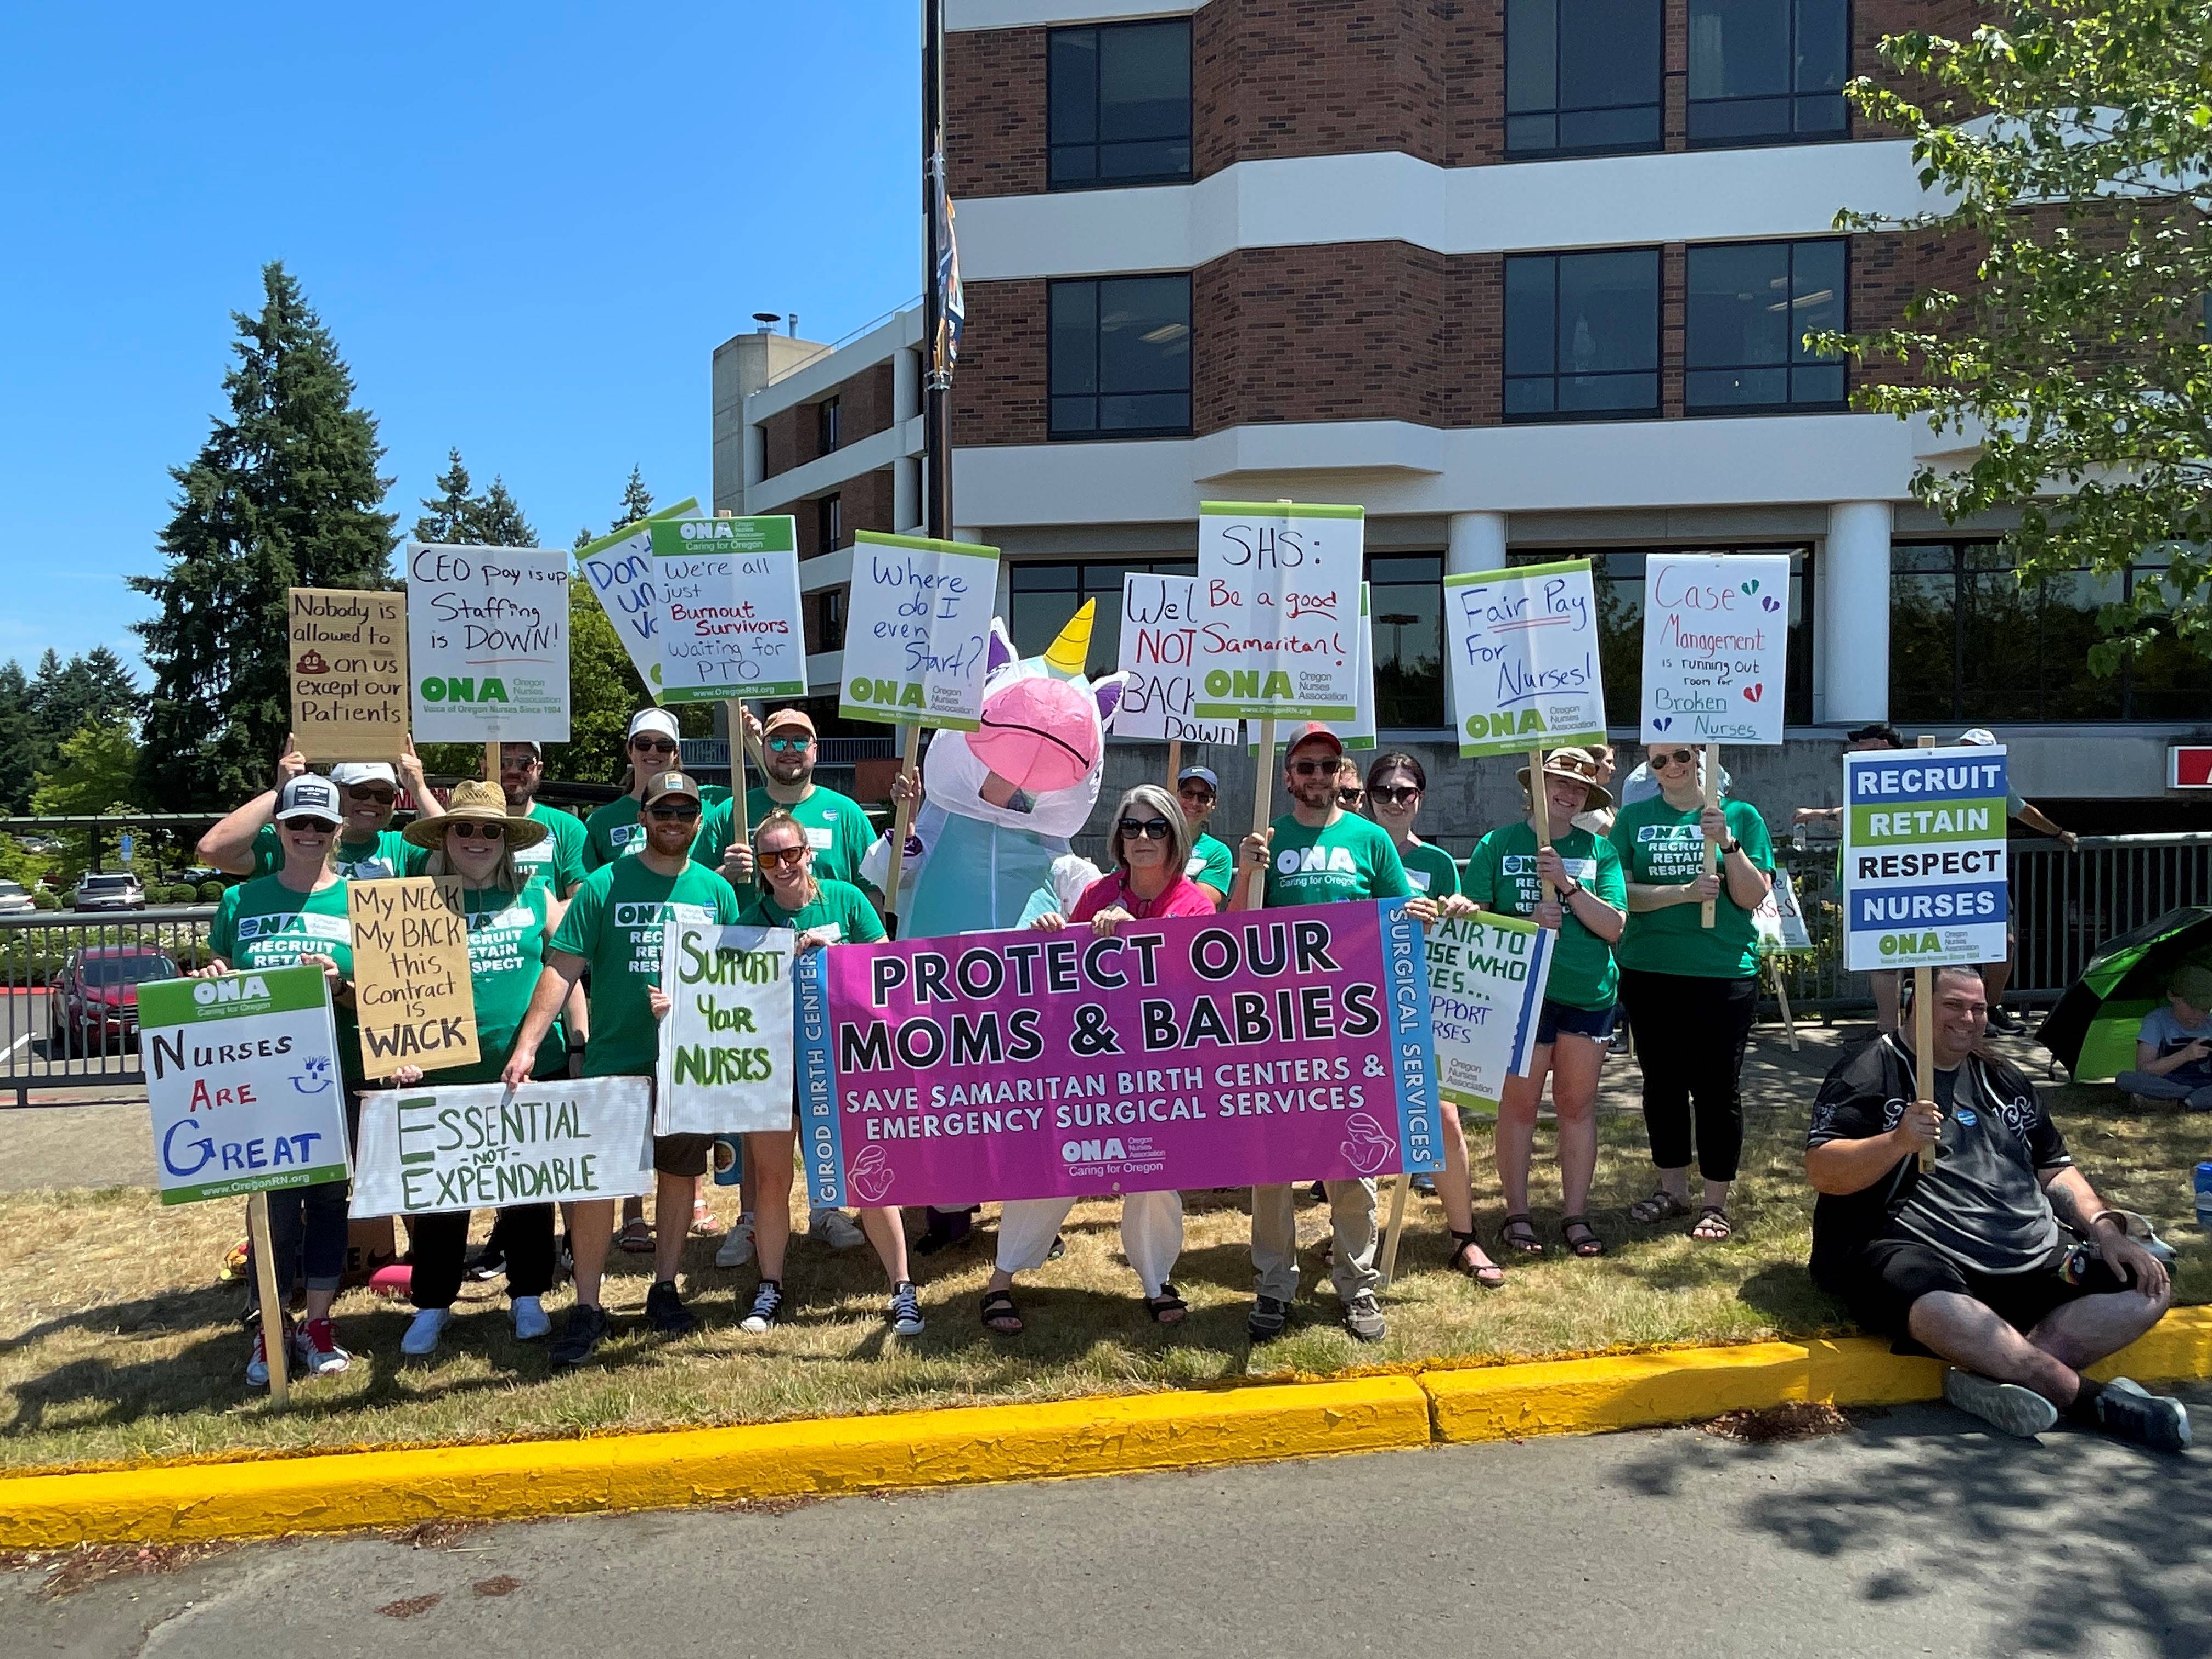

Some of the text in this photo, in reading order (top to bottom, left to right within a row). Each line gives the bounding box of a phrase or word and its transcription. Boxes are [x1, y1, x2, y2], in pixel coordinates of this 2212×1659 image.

[680, 522, 734, 540] ONA
[686, 540, 763, 551] Caring for Oregon
[1222, 525, 1321, 571] SHS:
[413, 550, 567, 586] CEO pay is up
[665, 557, 770, 579] We're all
[873, 556, 968, 592] Where
[658, 583, 701, 603] just
[1209, 579, 1337, 620] Be a good
[1656, 565, 1735, 610] Case
[294, 595, 397, 624] Nobody is
[431, 592, 540, 628] Staffing
[671, 601, 756, 622] Burnout
[898, 591, 960, 618] do I
[1460, 578, 1587, 631] Fair Pay
[293, 624, 391, 645] allowed to
[431, 625, 558, 653] is DOWN!
[694, 620, 789, 636] Survivors
[873, 620, 930, 639] even
[1660, 613, 1766, 658] Management
[752, 636, 786, 657] for
[1136, 628, 1197, 667] NOT
[1202, 622, 1346, 667] Samaritan!
[1466, 633, 1508, 665] For
[334, 656, 398, 674] on us
[697, 661, 760, 682] PTO
[905, 635, 983, 687] Start?
[1681, 658, 1729, 678] running
[296, 680, 403, 699] except our
[420, 676, 510, 702] ONA
[514, 678, 545, 688] Oregon
[1205, 669, 1295, 699] ONA
[1299, 672, 1332, 682] Oregon
[1299, 681, 1330, 691] Nurses
[1684, 676, 1711, 686] room
[693, 686, 775, 697] www.OregonRN.org
[850, 677, 926, 708] ONA
[932, 694, 959, 704] Nurses
[933, 686, 961, 697] Oregon
[1298, 691, 1347, 701] Association
[1656, 687, 1728, 711] Broken
[301, 701, 402, 723] Patients
[458, 705, 487, 715] Oregon
[489, 705, 517, 713] Nurses
[519, 706, 541, 714] Since
[930, 704, 974, 714] Association
[1549, 706, 1580, 715] Oregon
[1550, 714, 1579, 723] Nurses
[1466, 709, 1548, 740] ONA
[1551, 721, 1596, 731] Association
[1858, 765, 2001, 794] RECRUIT
[1870, 808, 1988, 837] RETAIN
[1277, 846, 1356, 874] ONA
[1859, 849, 2001, 878] RESPECT
[1279, 875, 1357, 888] Caring for Oregon
[355, 885, 460, 921] My NECK
[618, 905, 676, 924] ONA
[1863, 891, 1995, 921] NURSES
[248, 940, 336, 953] RECRUIT
[356, 920, 395, 951] My
[403, 916, 461, 947] BACK
[1492, 926, 1526, 955] TO
[1879, 932, 1942, 956] ONA
[388, 953, 442, 978] this
[871, 919, 1344, 1008] PROTECT OUR
[1467, 950, 1527, 981] WHO
[193, 976, 271, 1005] ONA
[363, 971, 457, 1005] Contract
[407, 1000, 426, 1018] is
[364, 1017, 467, 1059] WACK
[839, 983, 1381, 1075] MOMS & BABIES
[1388, 909, 1431, 1163] SURGICAL SERVICES
[1432, 1019, 1471, 1043] RSES
[152, 1030, 292, 1080] NURSES
[674, 1044, 772, 1086] NURSES
[1451, 1058, 1481, 1073] Oregon
[808, 1049, 830, 1116] BIRTH
[845, 1054, 1386, 1114] SAVE SAMARITAN BIRTH CENTERS &
[1446, 1076, 1493, 1094] Association
[1448, 1066, 1477, 1081] Nurses
[189, 1079, 257, 1113] ARE
[866, 1085, 1365, 1141] EMERGENCY SURGICAL SERVICES
[397, 1097, 591, 1165] ESSENTIAL
[163, 1118, 321, 1177] GREAT
[1062, 1138, 1127, 1162] ONA
[815, 1125, 838, 1202] GIROD
[1069, 1161, 1164, 1177] Caring for Oregon
[202, 1175, 310, 1196] www.OregonRN.org
[401, 1154, 599, 1210] EXPENDABLE
